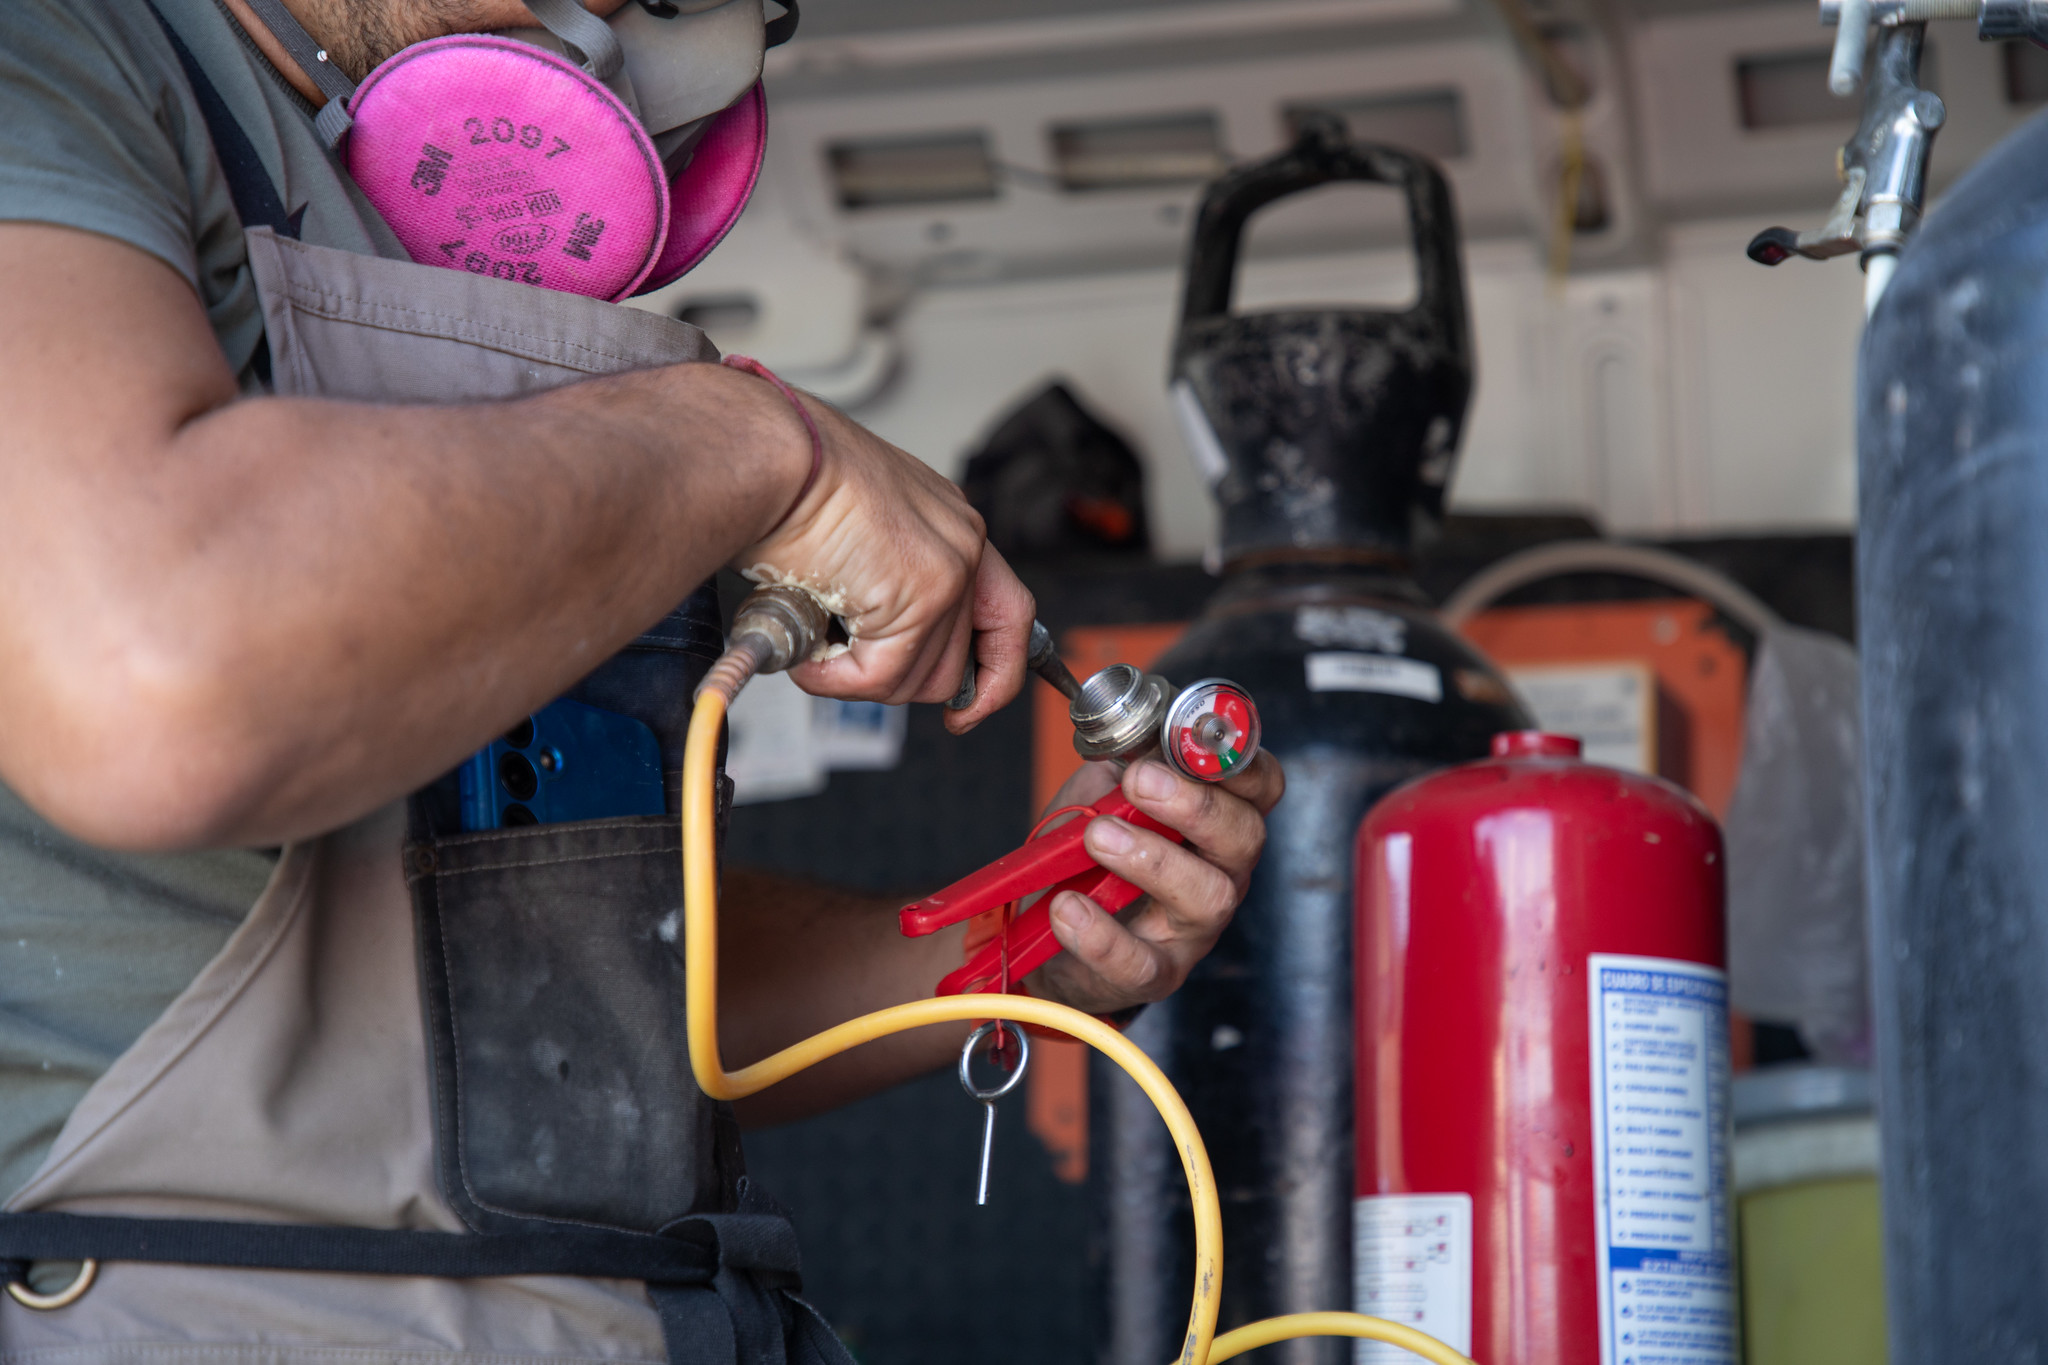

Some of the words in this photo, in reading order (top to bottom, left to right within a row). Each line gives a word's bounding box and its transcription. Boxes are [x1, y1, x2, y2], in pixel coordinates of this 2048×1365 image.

[463, 116, 571, 160] 2097
[410, 143, 454, 196] 3M
[562, 212, 606, 262] 3M
[439, 239, 544, 286] 2097
